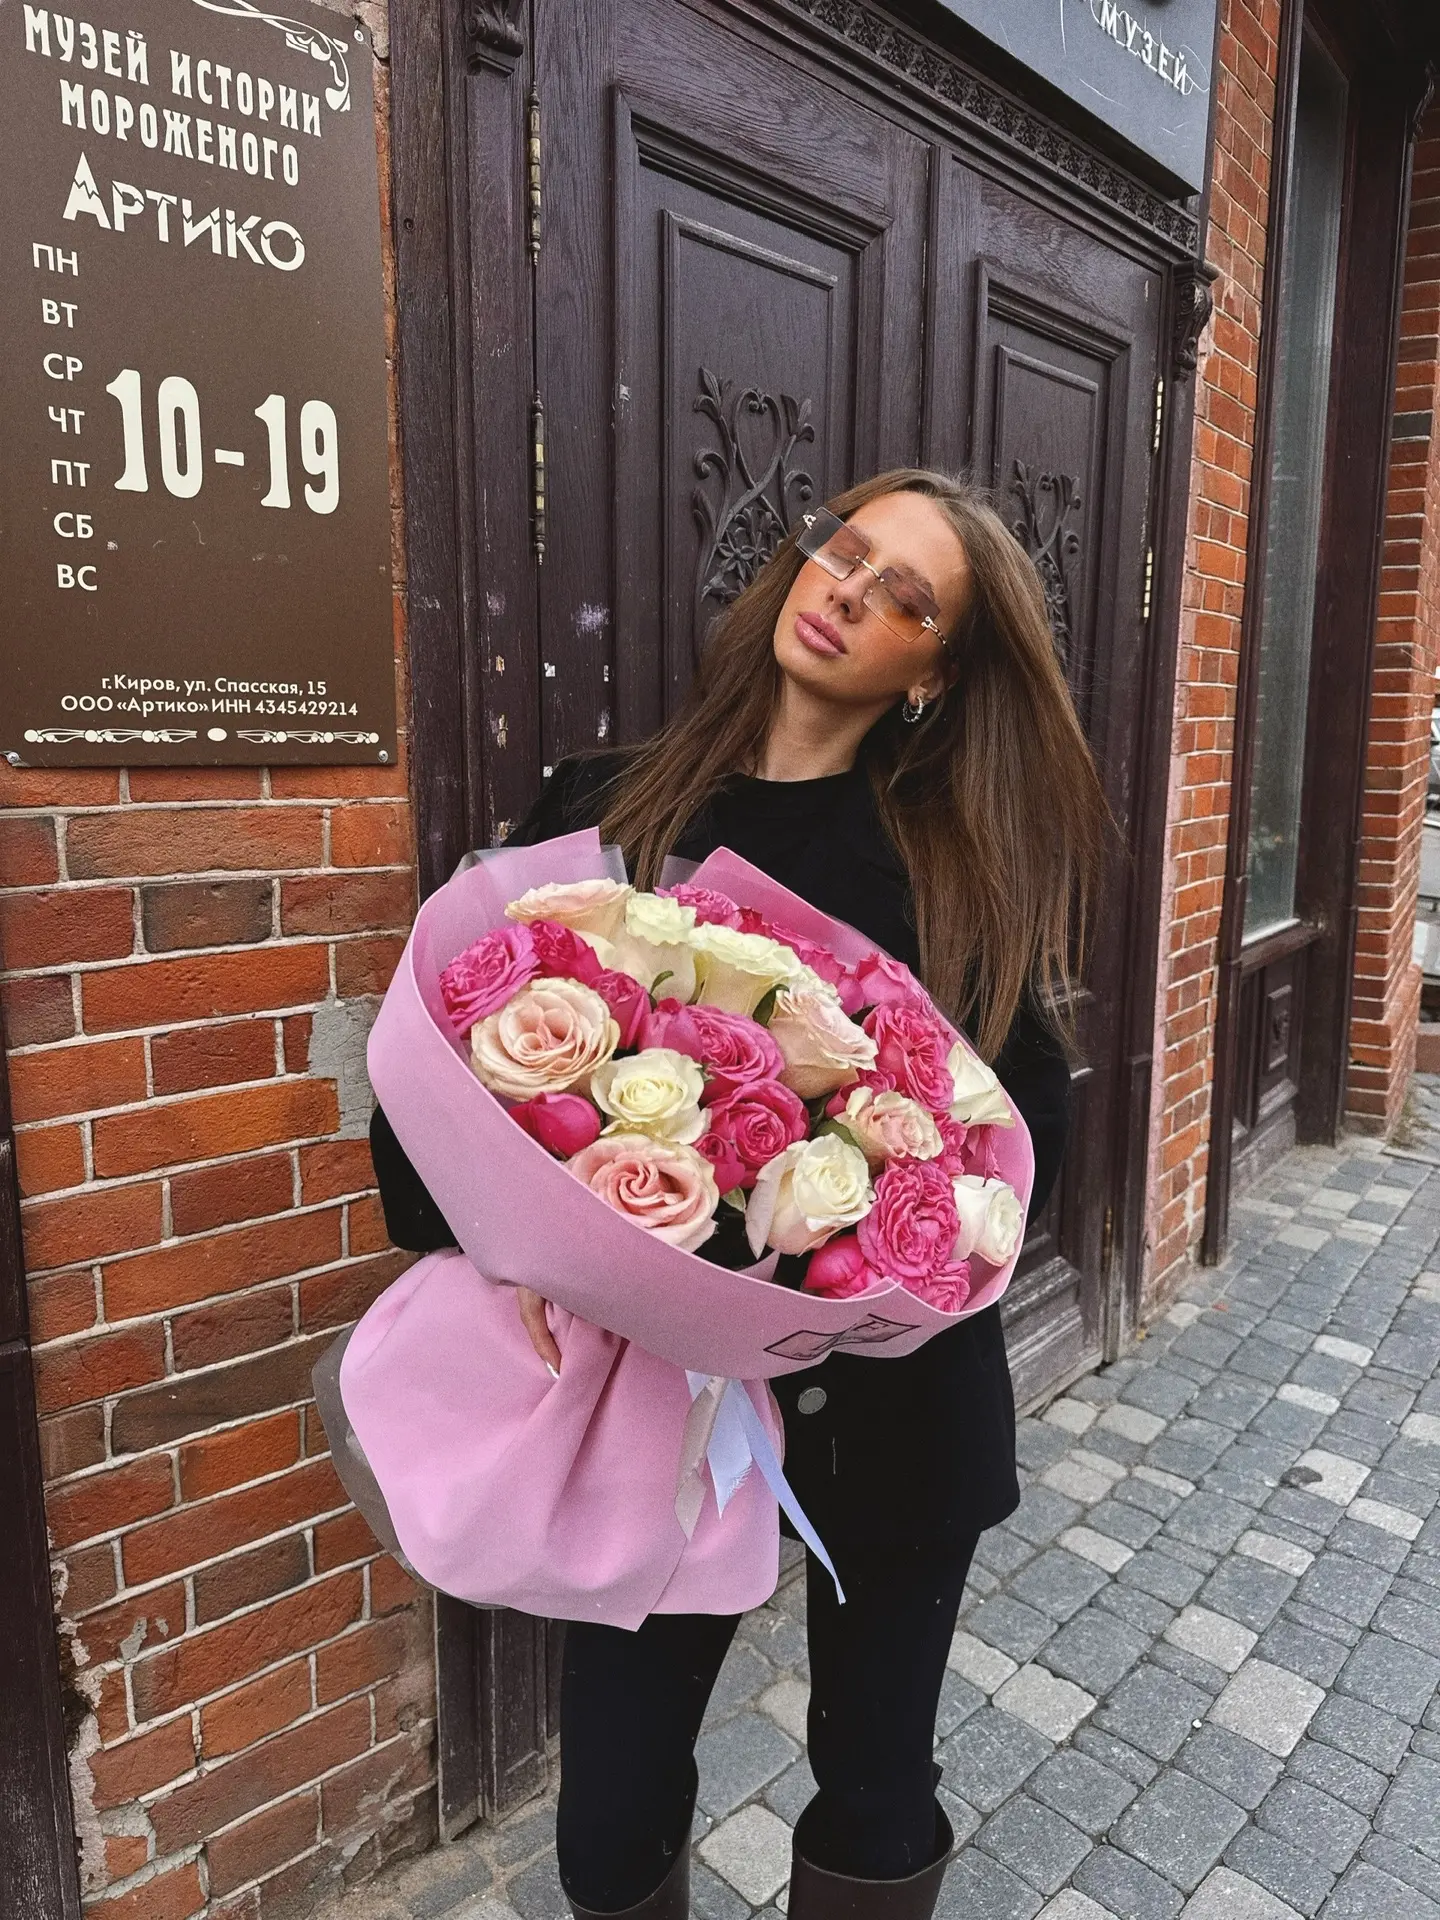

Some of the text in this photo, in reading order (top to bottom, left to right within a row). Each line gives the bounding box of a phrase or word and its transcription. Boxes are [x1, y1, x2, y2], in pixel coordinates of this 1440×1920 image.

[1100, 0, 1187, 95] МУЗЕЙ
[23, 4, 322, 138] МУЗЕЙ ИСТОРИИ
[59, 78, 299, 186] МОРОЖЕНОГО
[32, 242, 79, 277] ПН
[41, 298, 78, 328] ВТ
[43, 352, 83, 381] СР
[48, 405, 85, 434] ЧТ
[105, 368, 340, 515] 10-19
[51, 459, 91, 487] ПТ
[53, 511, 94, 539] СБ
[57, 563, 98, 591] ВС
[184, 680, 211, 697] ул.
[215, 677, 304, 697] Спасская,
[307, 680, 327, 696] 15
[61, 695, 358, 718] ООО «Артико» ИНН 4345429214
